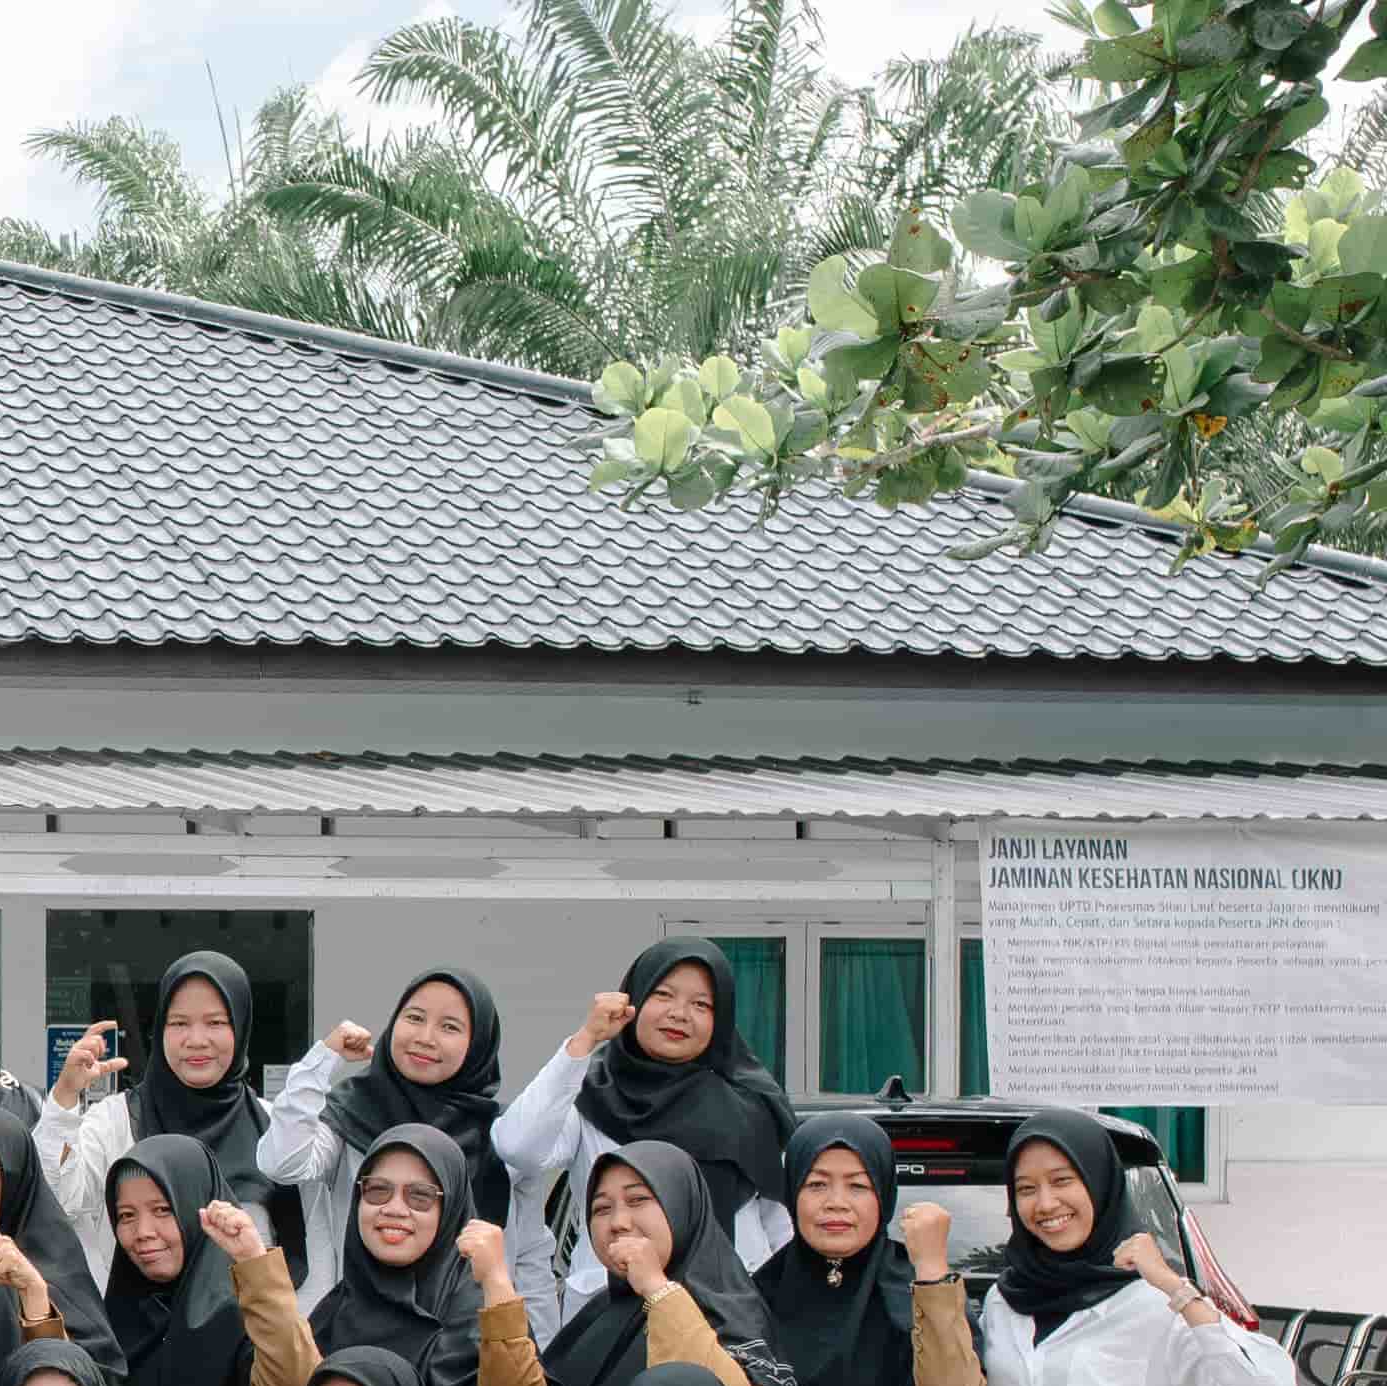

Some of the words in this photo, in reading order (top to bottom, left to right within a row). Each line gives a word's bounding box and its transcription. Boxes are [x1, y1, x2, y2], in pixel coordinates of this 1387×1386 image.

[988, 837, 1036, 859] JANJI
[1042, 838, 1128, 860] LAYANAN
[988, 867, 1073, 889] JAMINAN
[1078, 867, 1188, 889] KESEHATAN
[1194, 867, 1289, 889] NASIONAL
[1291, 867, 1343, 890] (JKN)
